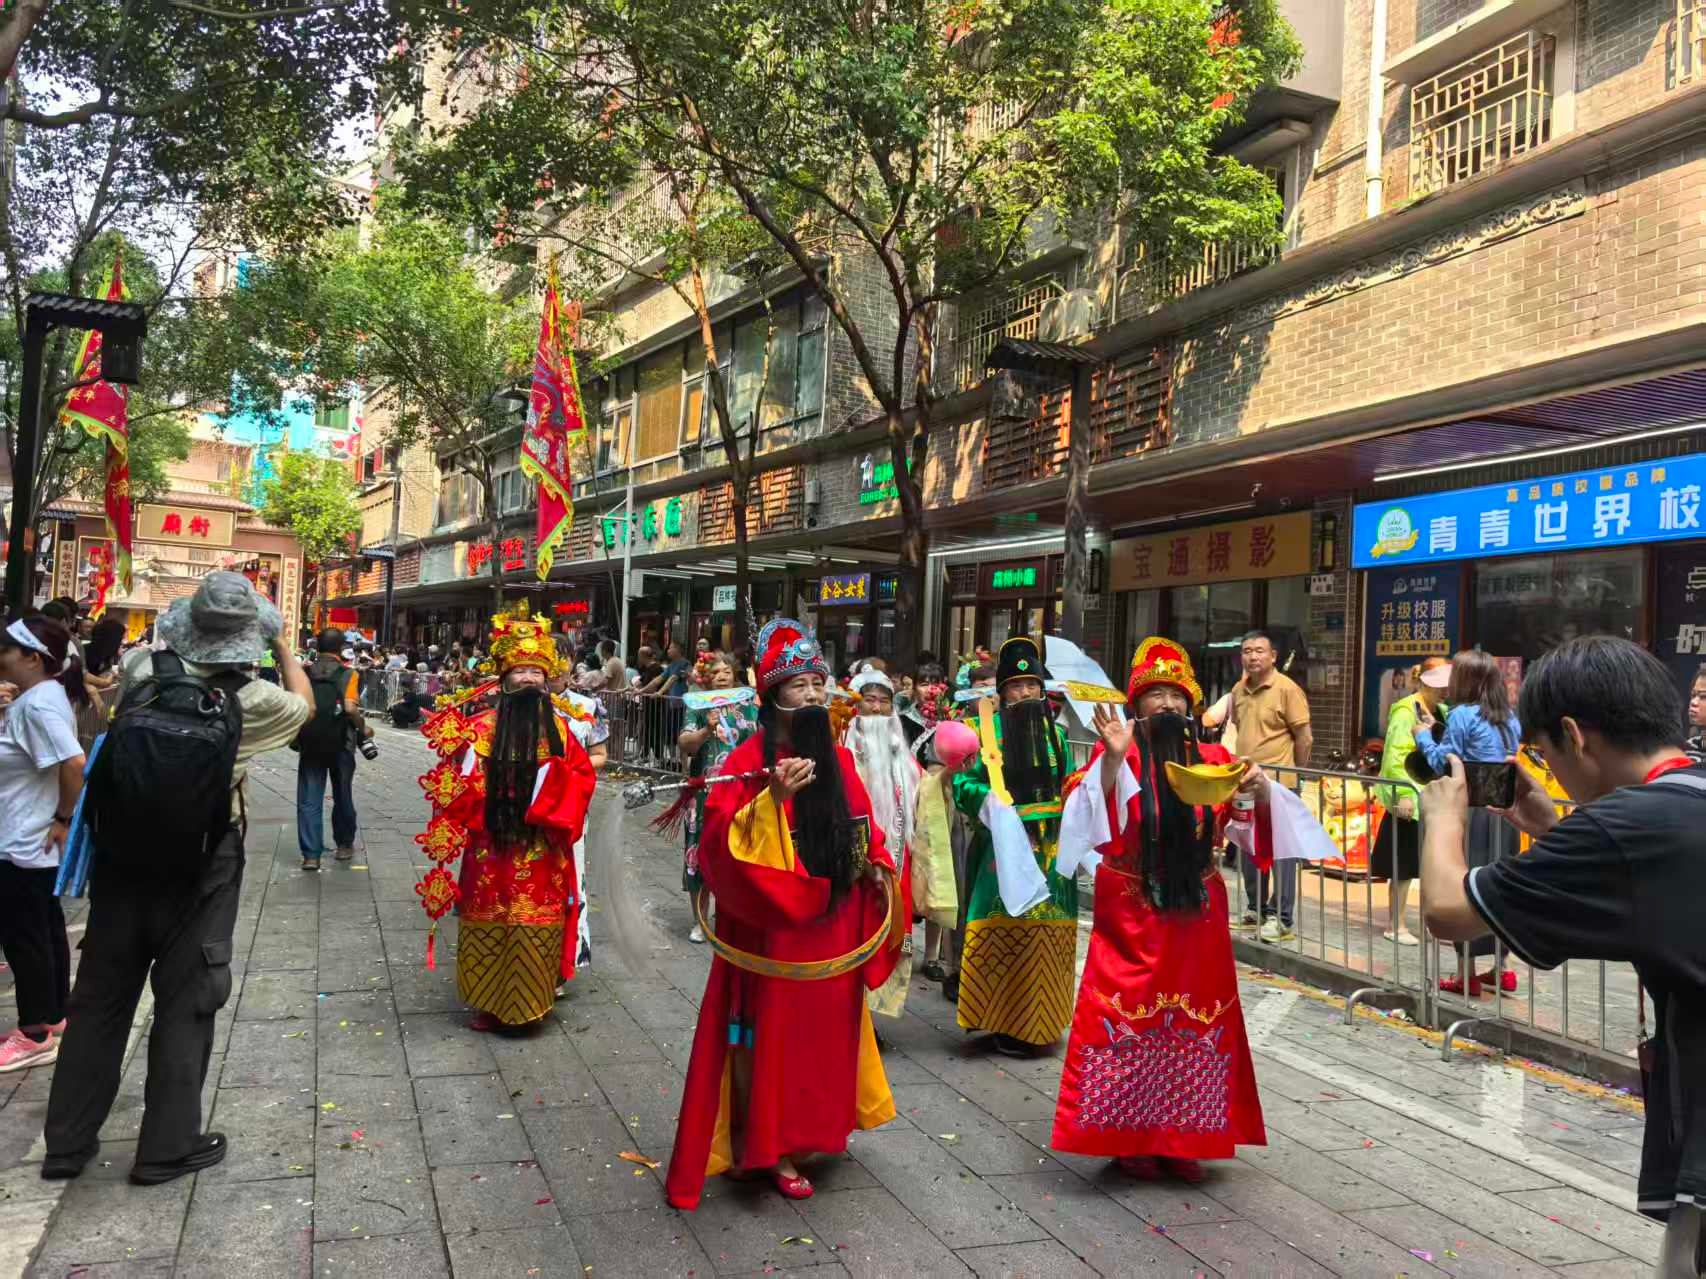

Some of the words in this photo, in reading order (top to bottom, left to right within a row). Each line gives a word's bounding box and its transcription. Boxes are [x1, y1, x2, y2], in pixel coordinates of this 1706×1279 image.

[1428, 484, 1701, 554] 青青世界校
[1133, 524, 1276, 580] 宝通摄影
[1380, 599, 1447, 621] 升级校服
[1380, 621, 1447, 641] 特级校服
